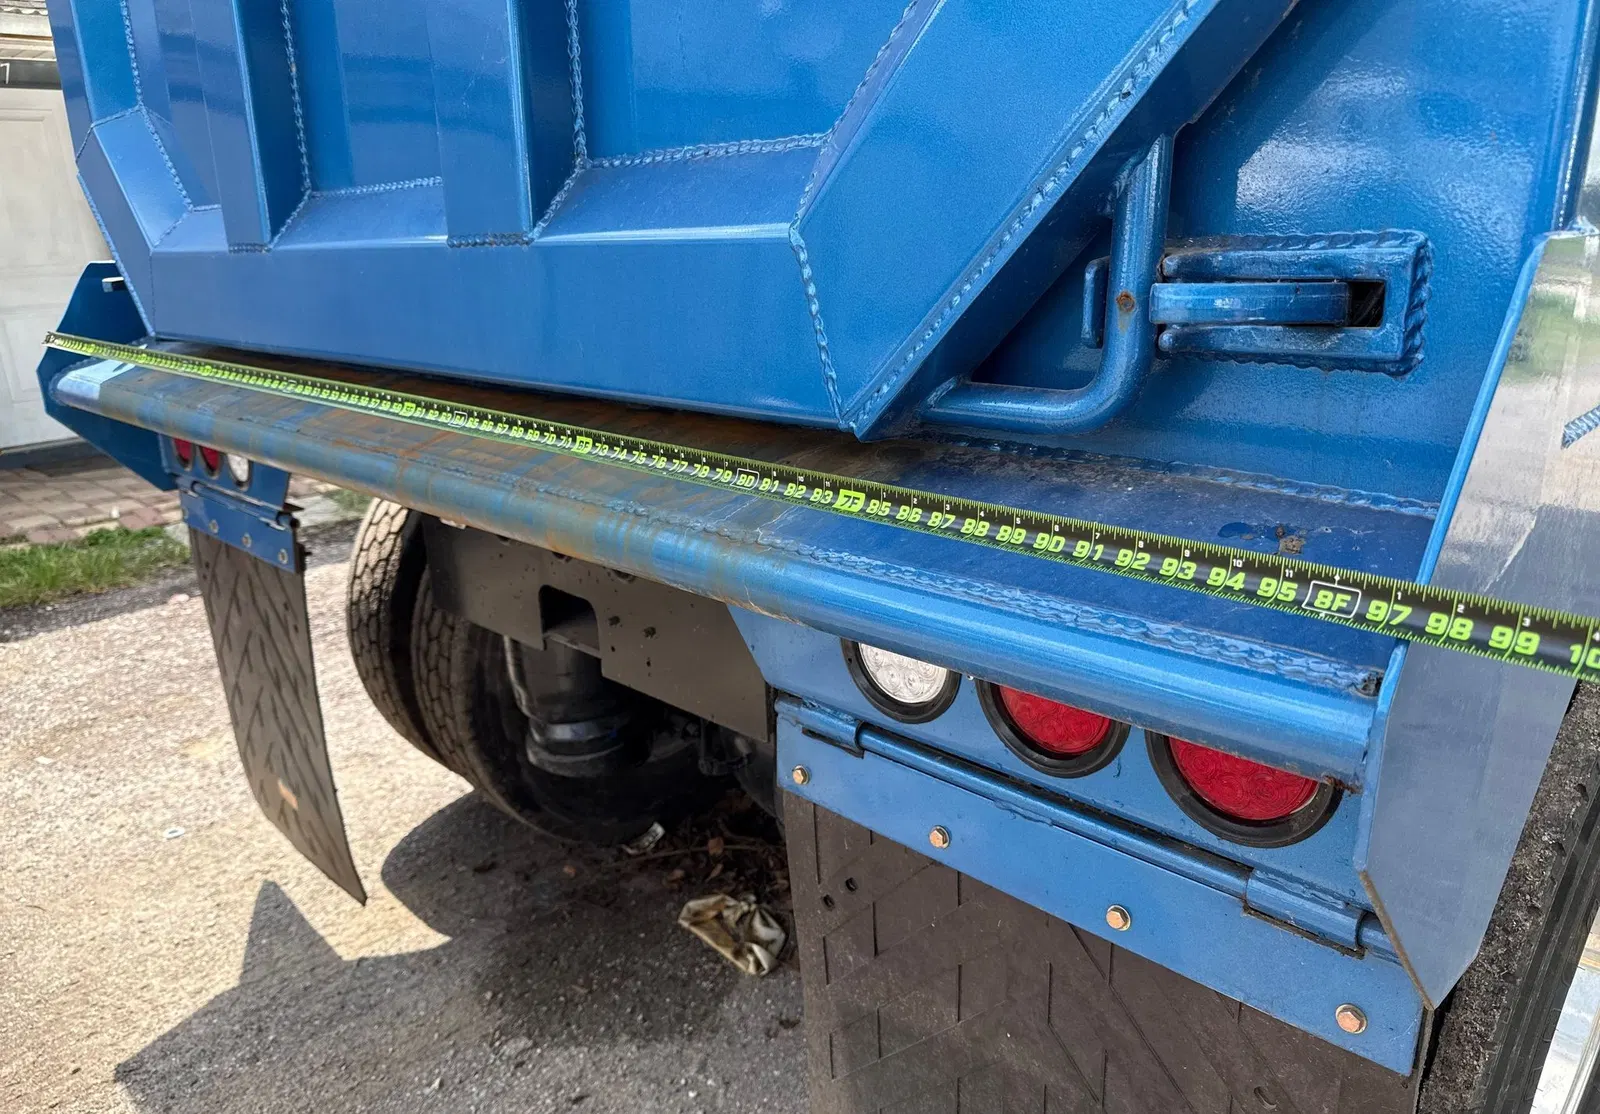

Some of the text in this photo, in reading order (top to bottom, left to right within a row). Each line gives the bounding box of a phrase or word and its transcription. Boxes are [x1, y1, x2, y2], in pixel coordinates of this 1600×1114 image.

[426, 410, 439, 420] 62
[465, 417, 479, 428] 65
[480, 420, 494, 431] 66
[494, 423, 509, 434] 67
[509, 426, 524, 437] 68
[525, 429, 540, 441] 69
[540, 432, 556, 444] 70
[557, 436, 572, 448] 71
[592, 443, 609, 456] 73
[611, 447, 627, 460] 74
[629, 451, 647, 464] 75
[648, 455, 667, 468] 76
[669, 459, 688, 472] 77
[690, 464, 710, 478] 78
[712, 468, 732, 482] 79
[737, 474, 755, 487] 80
[759, 478, 779, 492] 81
[784, 483, 806, 498] 82
[810, 488, 833, 504] 83
[866, 499, 891, 516] 85
[896, 505, 922, 523] 86
[927, 512, 956, 529] 87
[960, 518, 990, 537] 88
[996, 526, 1026, 544] 89
[1032, 533, 1066, 552] 90
[1072, 540, 1105, 561] 91
[1114, 549, 1150, 570] 92
[1159, 558, 1197, 580] 93
[1206, 567, 1246, 591] 94
[1256, 577, 1298, 602] 95
[1314, 589, 1351, 611] 8F
[1365, 600, 1412, 626] 97
[1425, 612, 1474, 640] 98
[1488, 625, 1540, 655] 99
[1184, 549, 1190, 558] 9
[1232, 559, 1242, 568] 10
[1285, 569, 1294, 578] 11
[1397, 592, 1402, 600] 1
[1457, 604, 1465, 613] 2
[1522, 617, 1531, 627] 3
